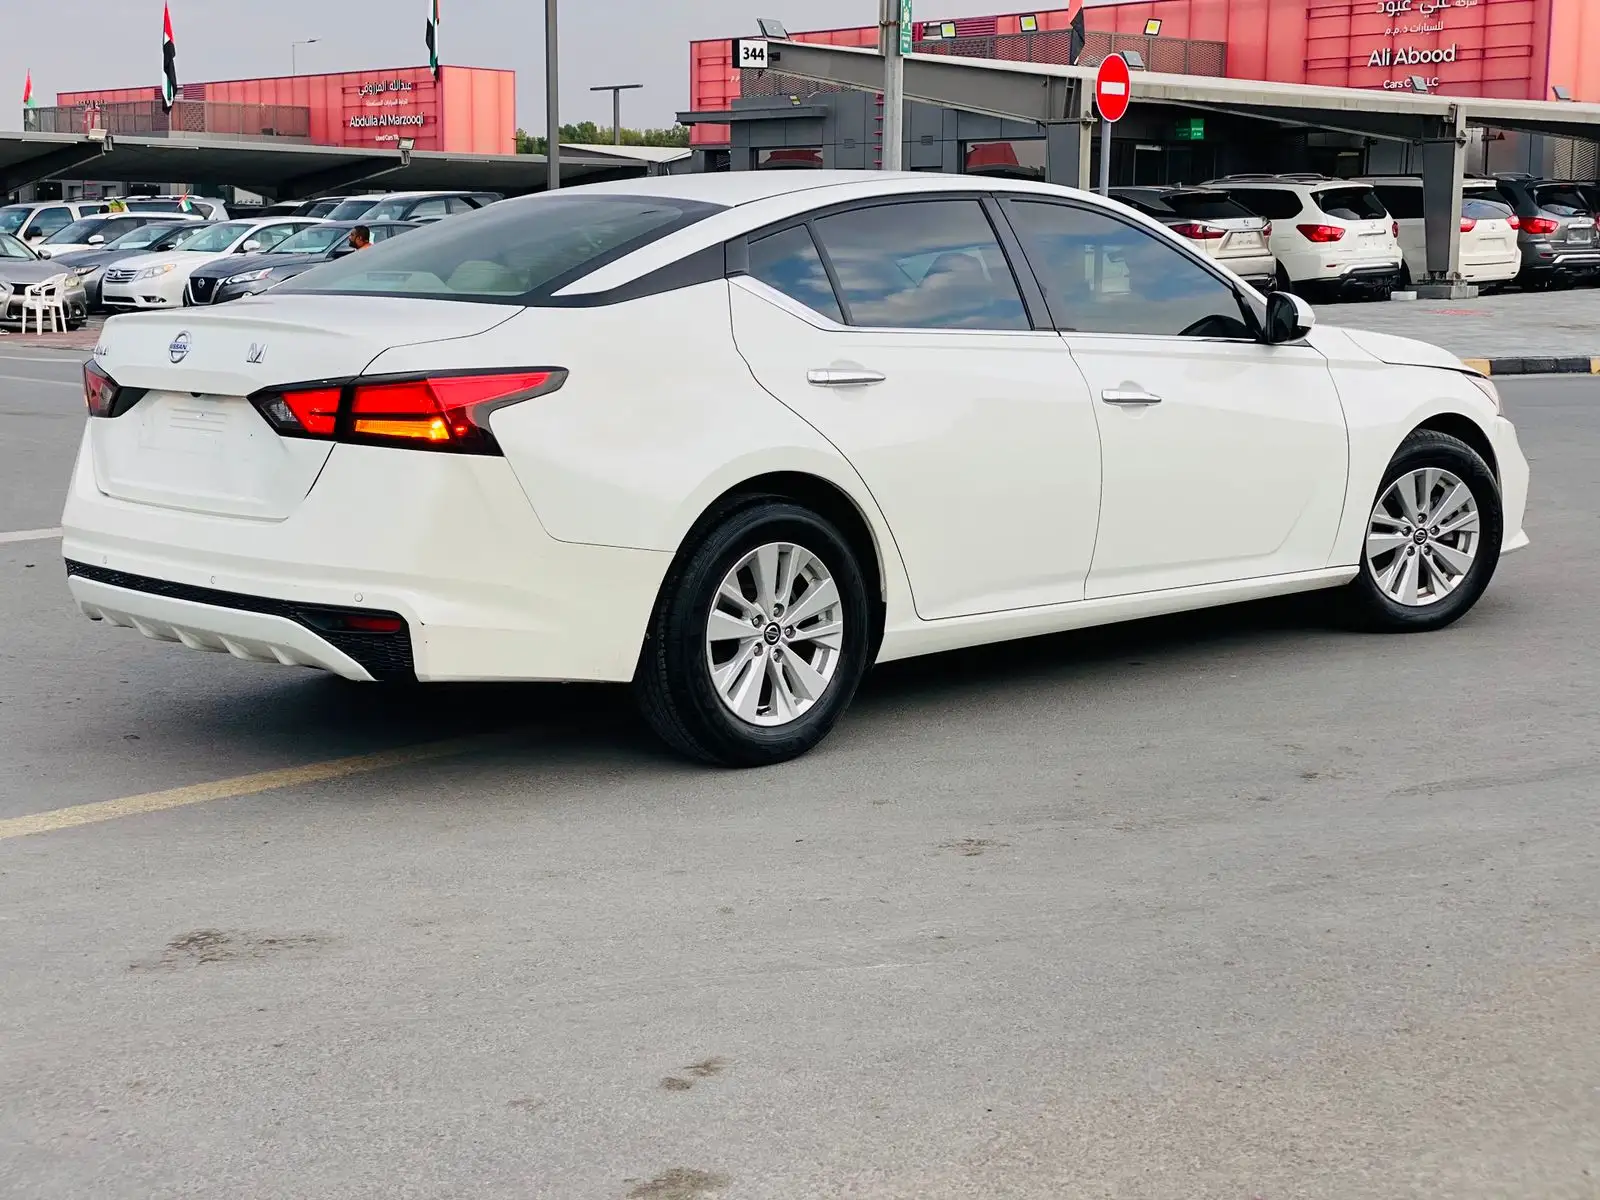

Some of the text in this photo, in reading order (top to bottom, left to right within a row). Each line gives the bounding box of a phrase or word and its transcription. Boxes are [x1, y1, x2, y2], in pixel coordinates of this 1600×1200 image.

[1410, 21, 1444, 34] للسيارات
[743, 46, 765, 61] 344
[1367, 43, 1456, 67] Ali Abood
[1383, 79, 1403, 89] Cars
[349, 112, 424, 127] Abdulla Al Marzooqi
